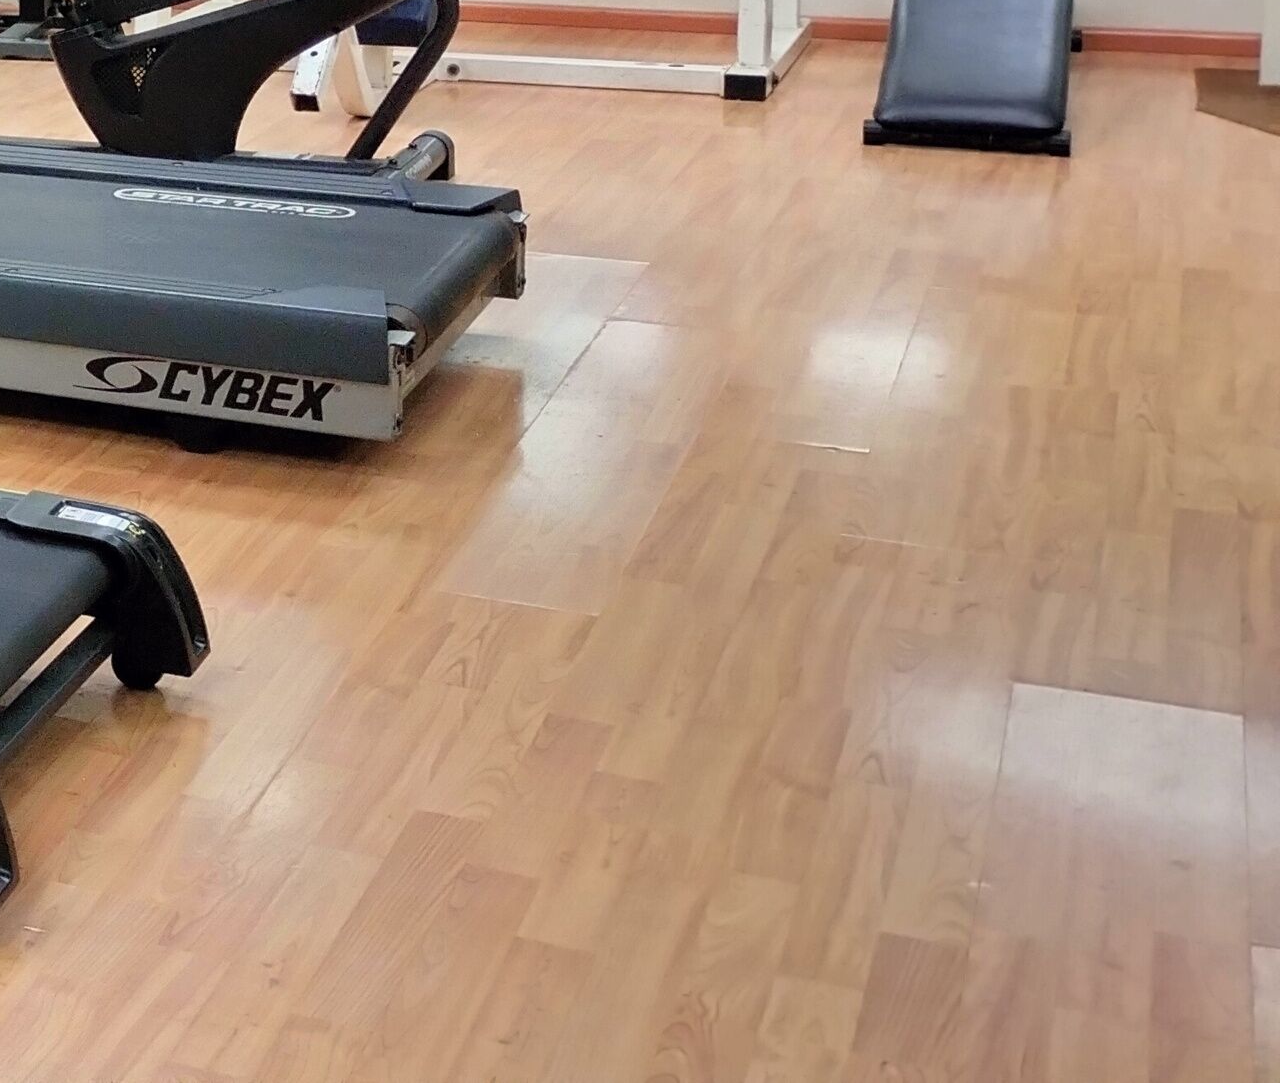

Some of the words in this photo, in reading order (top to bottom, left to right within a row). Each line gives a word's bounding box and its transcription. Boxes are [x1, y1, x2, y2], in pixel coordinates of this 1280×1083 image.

[129, 190, 228, 206] STAR
[234, 199, 338, 216] TRAC
[159, 361, 335, 421] CYBEX
